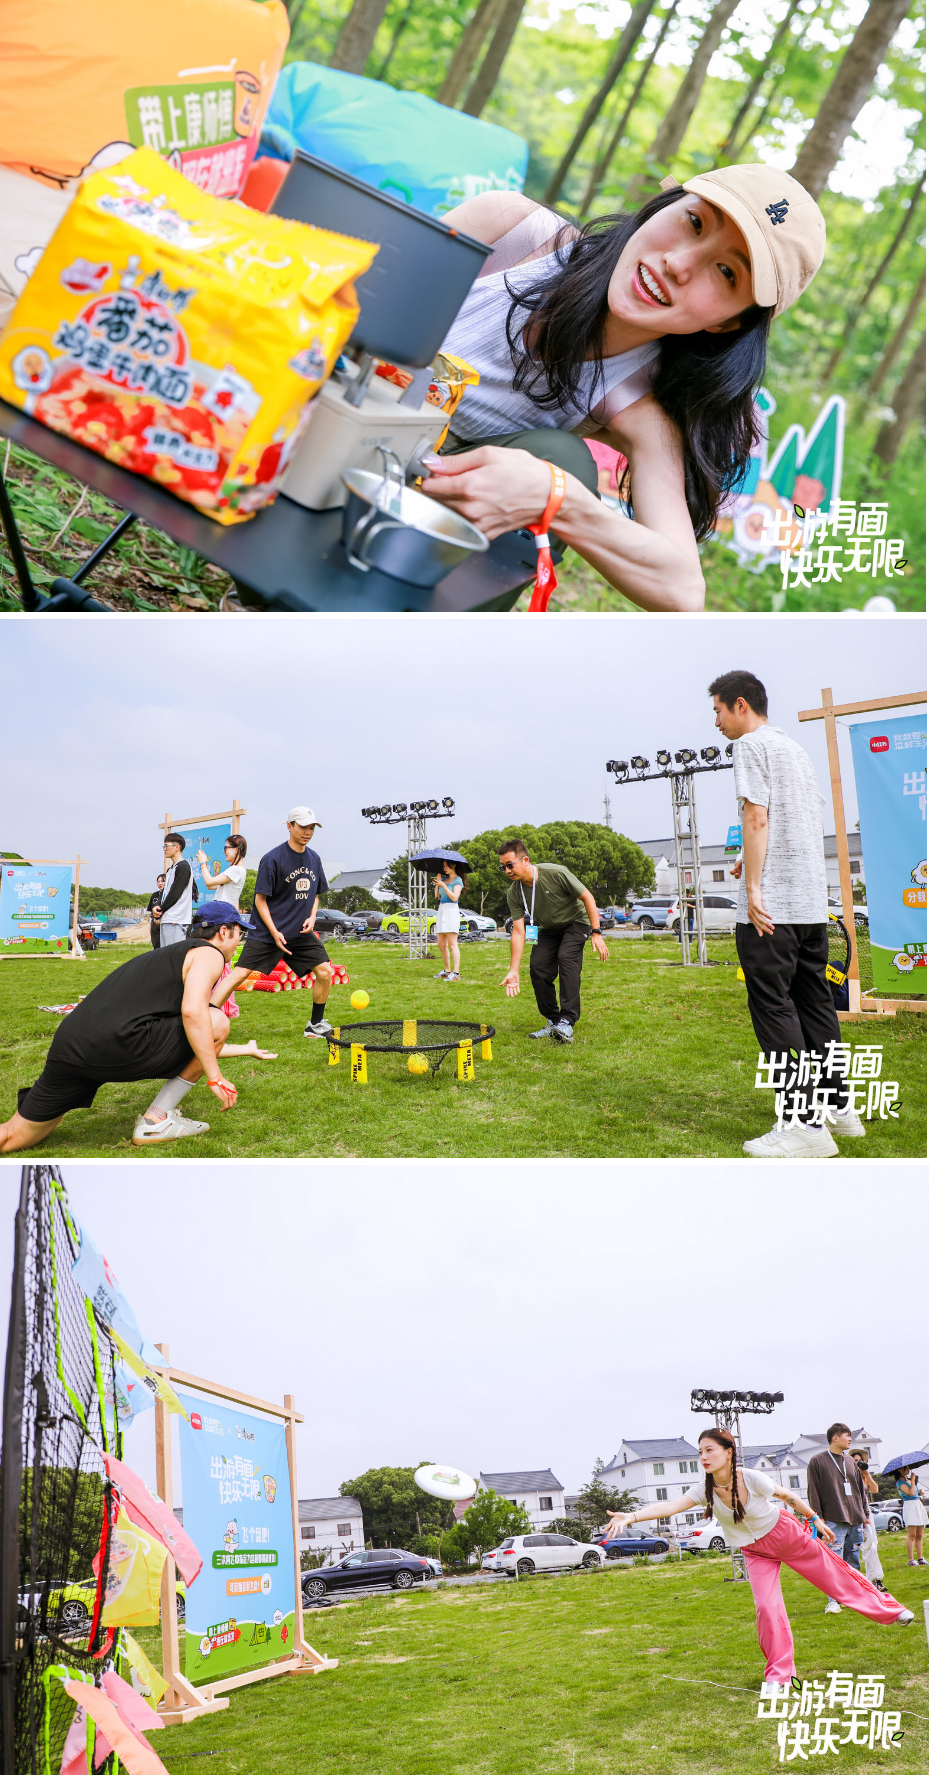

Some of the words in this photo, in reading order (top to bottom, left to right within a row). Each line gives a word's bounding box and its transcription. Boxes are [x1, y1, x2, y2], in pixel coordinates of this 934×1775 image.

[765, 199, 789, 225] LA
[98, 296, 173, 356] 番茄
[907, 890, 927, 903] 分数
[210, 1455, 254, 1480] 出游有面
[219, 1477, 261, 1504] 快乐无限
[241, 1526, 270, 1543] 飞个盘吧!
